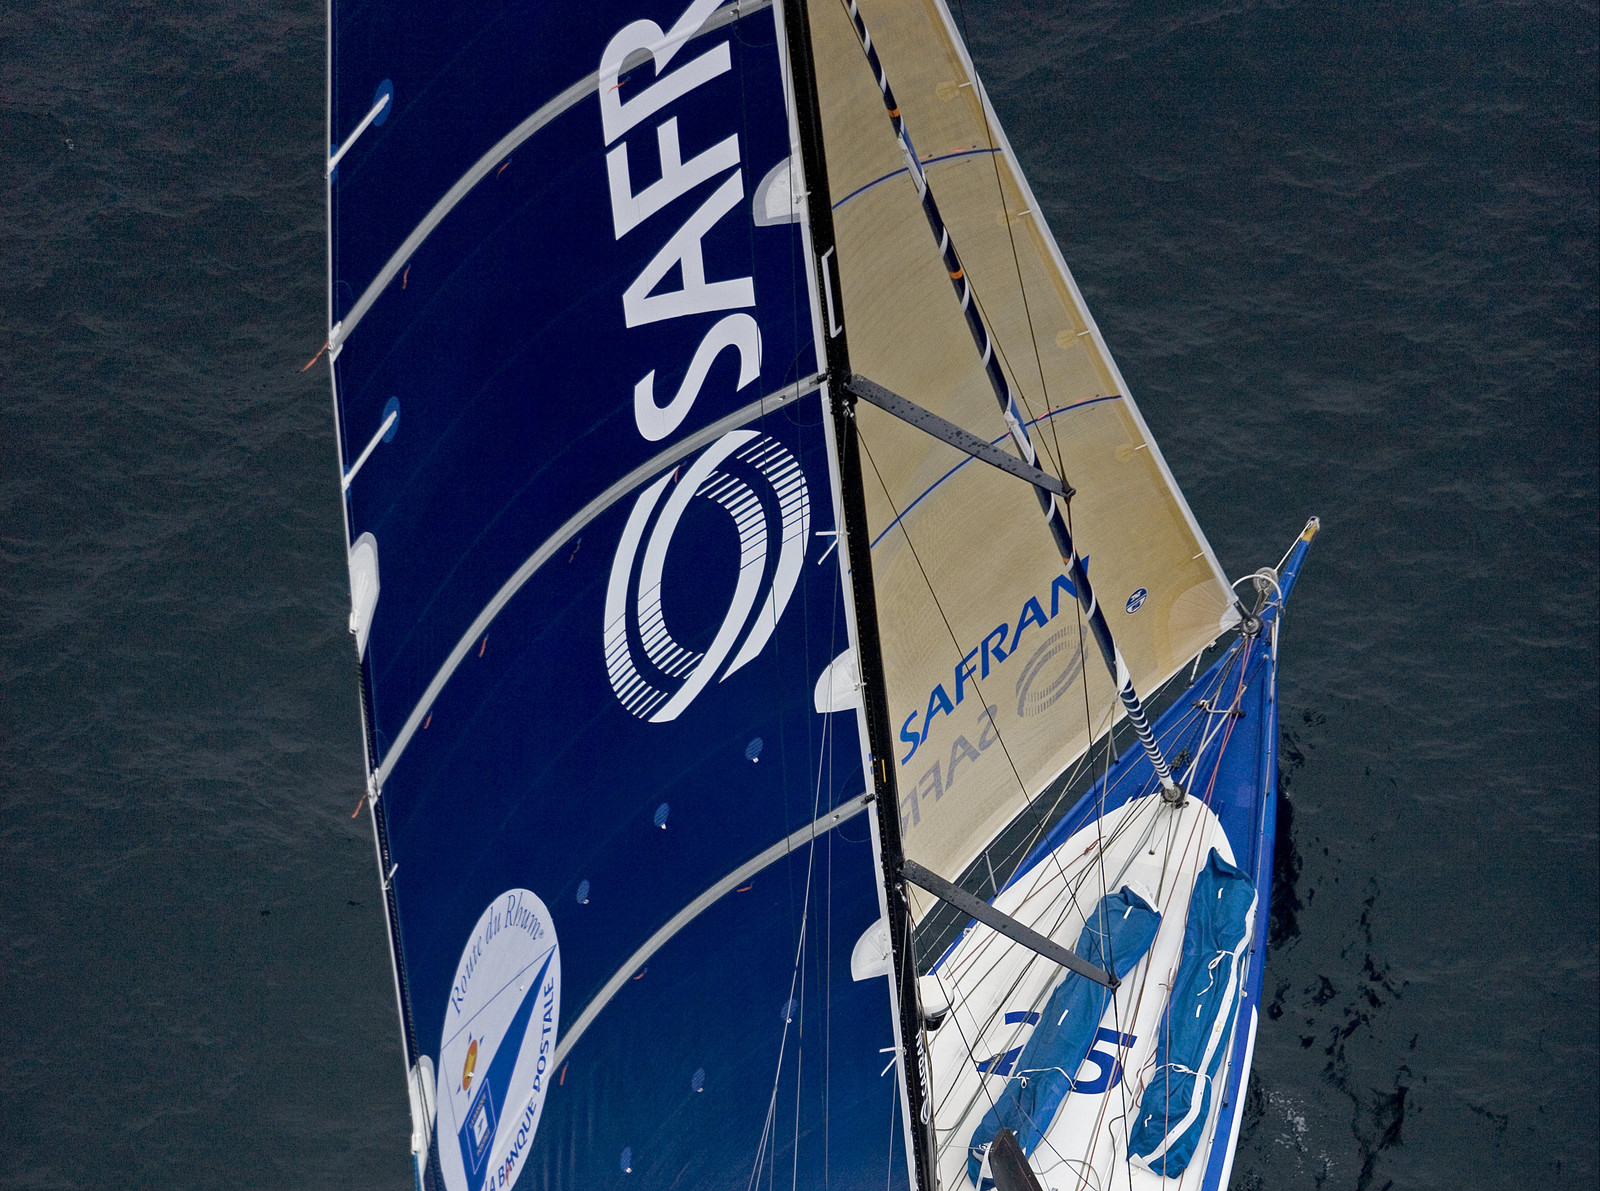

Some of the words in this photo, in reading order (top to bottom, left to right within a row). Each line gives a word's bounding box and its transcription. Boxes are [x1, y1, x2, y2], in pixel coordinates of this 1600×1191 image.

[900, 554, 1090, 766] SAFRAN
[486, 906, 501, 944] du
[499, 1098, 537, 1186] BANQUE
[533, 977, 554, 1092] POSTALE
